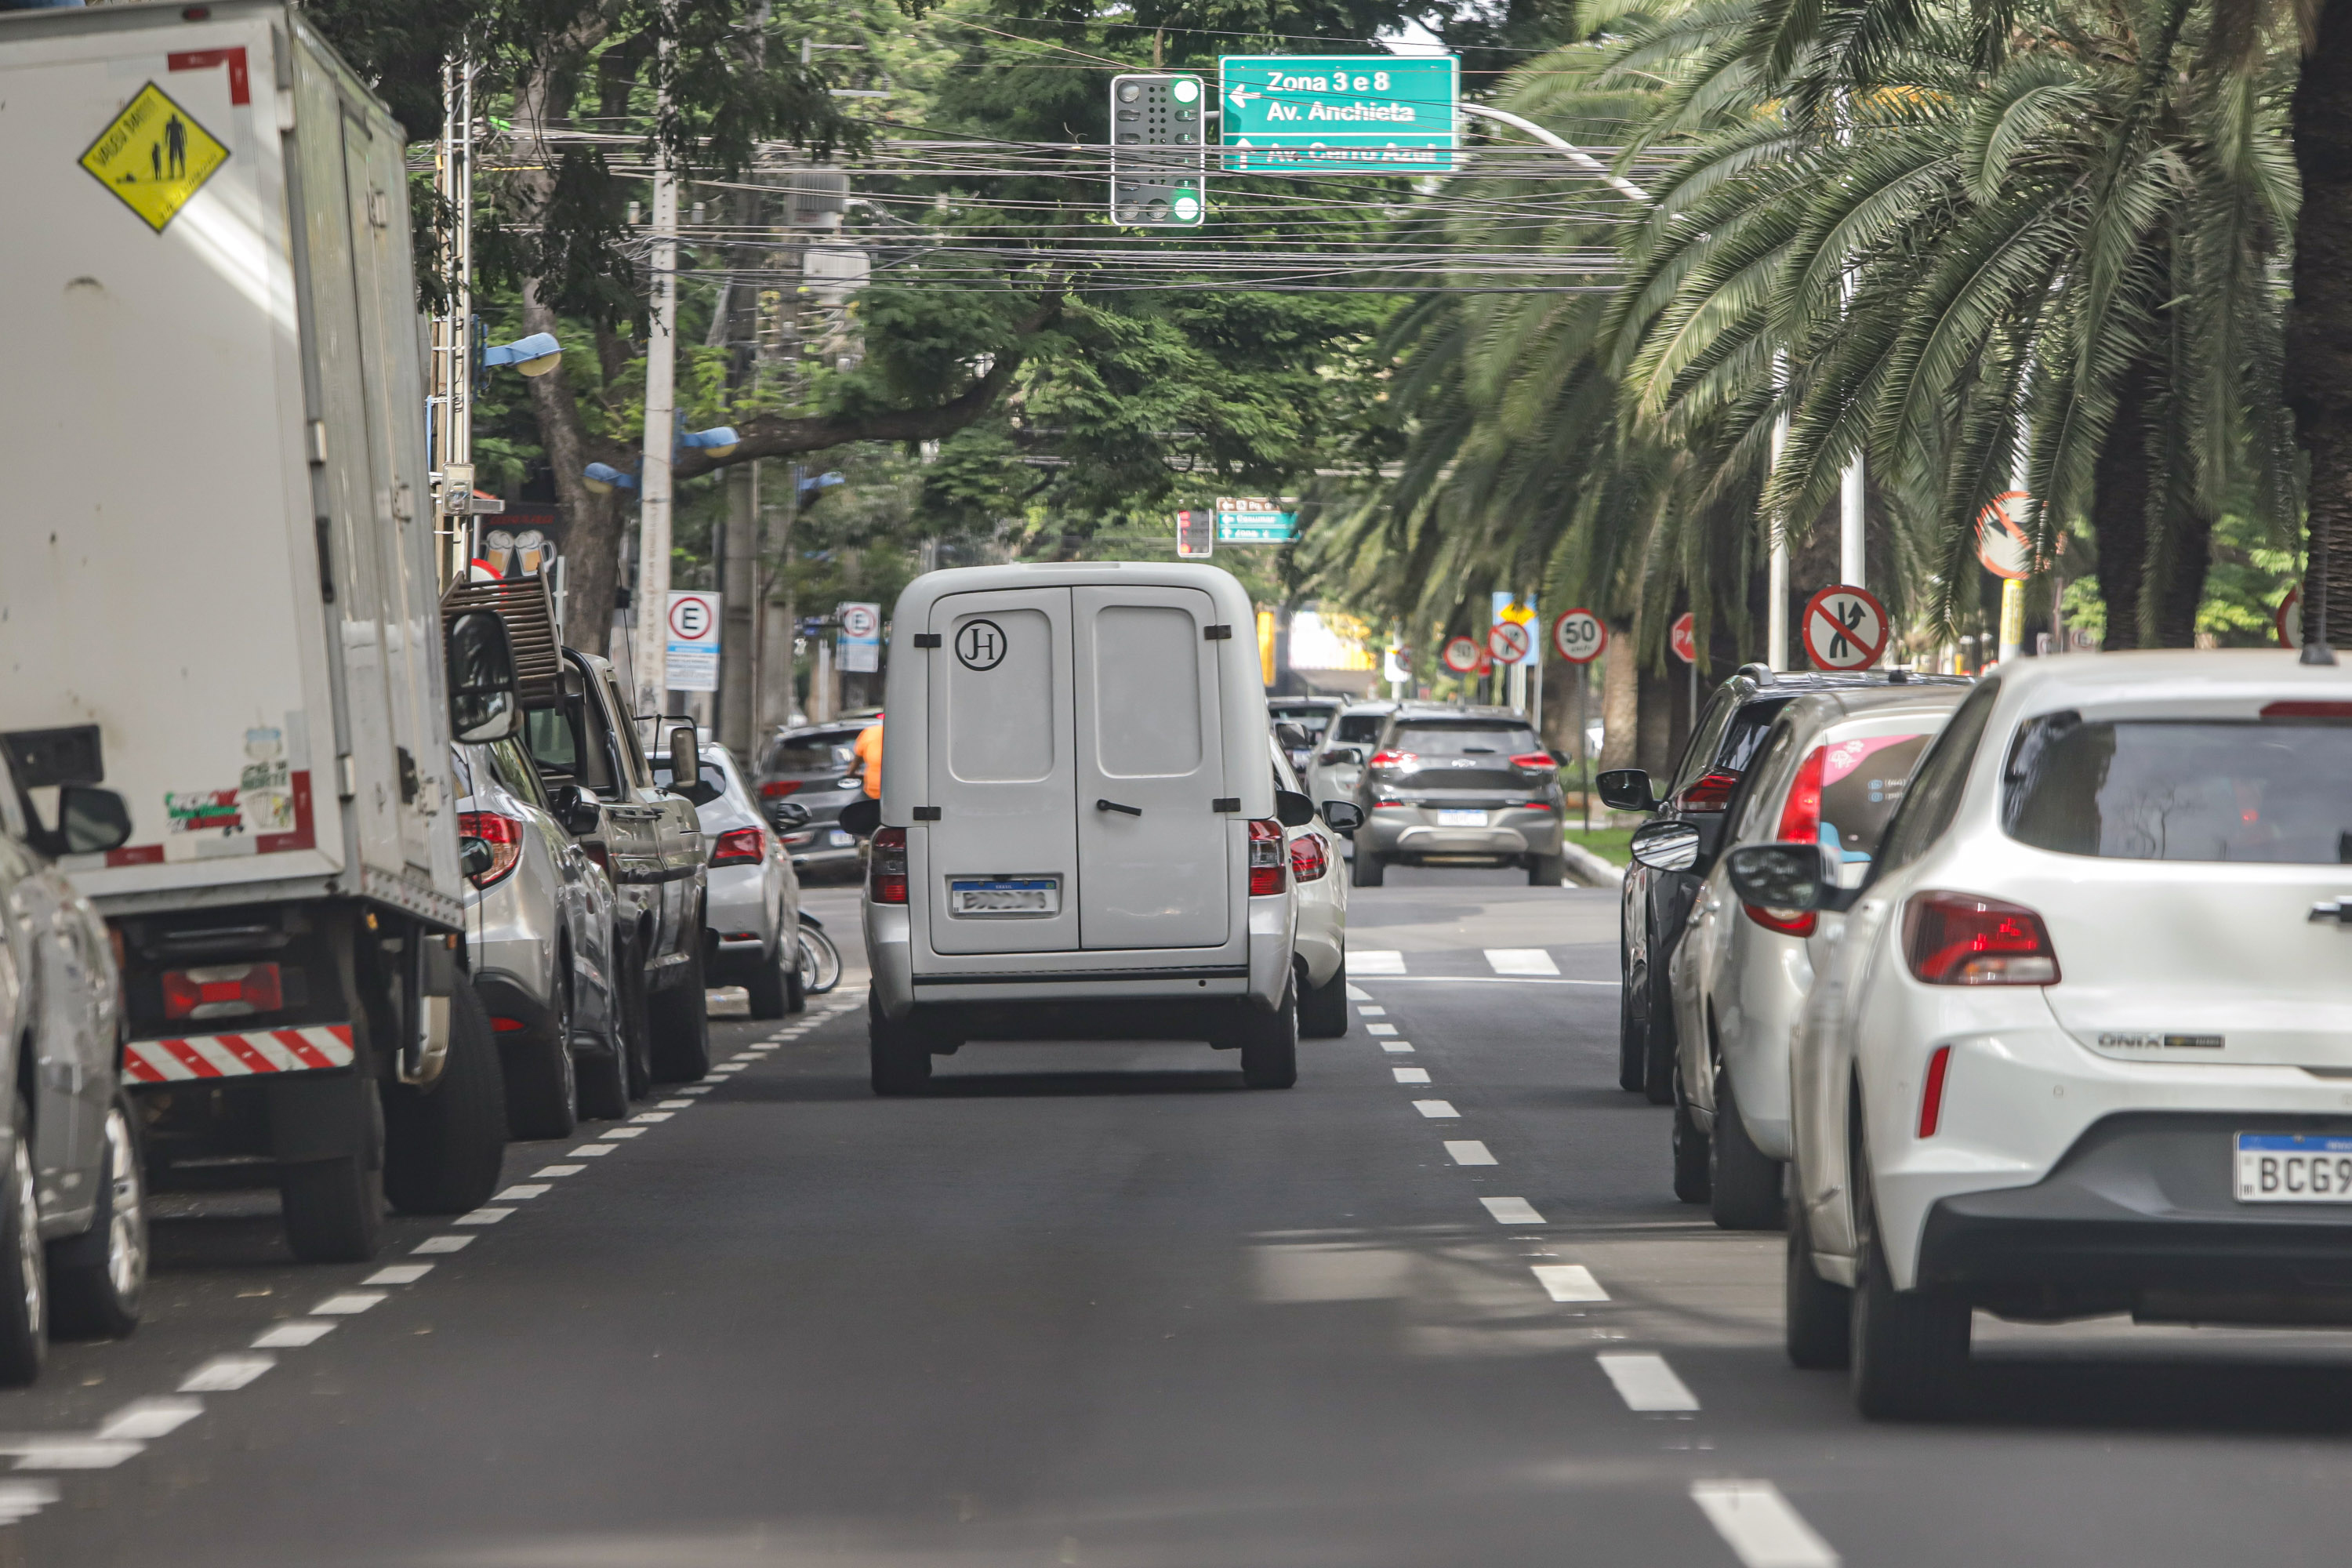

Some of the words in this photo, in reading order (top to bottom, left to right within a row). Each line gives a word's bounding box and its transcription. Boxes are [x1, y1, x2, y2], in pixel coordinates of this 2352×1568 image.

[1266, 71, 1327, 92] Zona
[1333, 71, 1348, 91] 3
[1353, 76, 1370, 91] e
[1374, 71, 1391, 91] 8
[1266, 101, 1302, 122] Av.
[1308, 101, 1416, 122] Anchieta
[682, 608, 699, 630] E
[1566, 620, 1595, 644] 50
[1676, 629, 1693, 645] PA
[2260, 1156, 2352, 1194] BCG9
